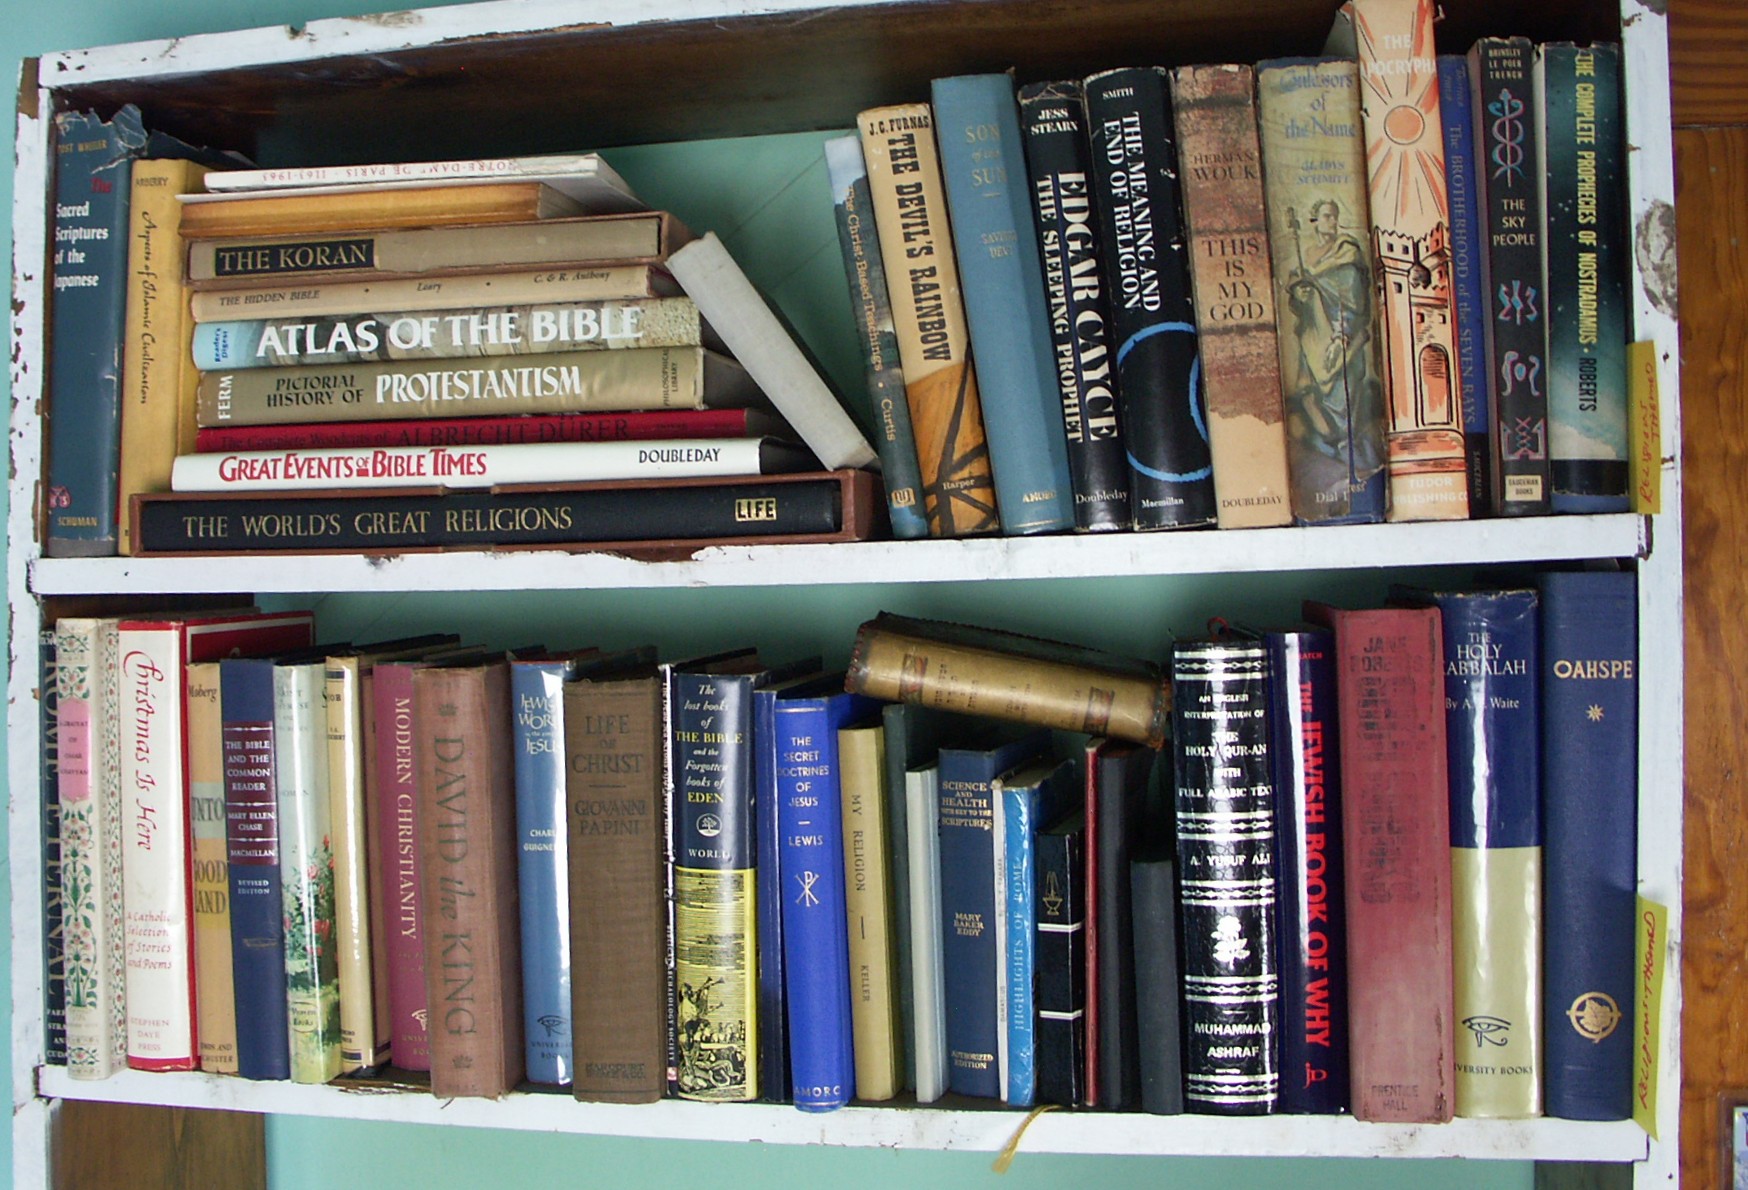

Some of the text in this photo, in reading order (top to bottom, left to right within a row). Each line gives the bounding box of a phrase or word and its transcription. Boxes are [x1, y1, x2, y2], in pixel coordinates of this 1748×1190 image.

[1384, 34, 1411, 49] THE
[1102, 87, 1134, 100] SMITH
[1038, 107, 1069, 120] JESS
[889, 115, 931, 132] FURNAS
[1031, 120, 1079, 136] STEARN
[965, 124, 1000, 144] SON
[1193, 151, 1254, 164] HERMAN
[971, 168, 1008, 188] SUN
[1194, 165, 1258, 181] WOUK
[57, 202, 90, 218] Sacred
[1123, 111, 1161, 312] THE MEANING AND
[1502, 199, 1526, 211] THE
[1104, 119, 1141, 310] END OF RELIGION
[1502, 216, 1526, 229] SKY
[55, 225, 109, 242] Scriptures
[1493, 234, 1536, 246] PEOPLE
[1575, 54, 1599, 412] THE COMPLETE PROPHECIES OF NOSTRADAMUS ROBERTS
[888, 133, 952, 361] THE DEVIL'S RAINBOW
[1202, 237, 1260, 257] THIS
[55, 248, 86, 265] of the
[219, 243, 369, 272] THE KORAN
[1226, 260, 1245, 277] IS
[1448, 123, 1475, 424] The BROTHERHOOD of the SEVEN RAYS
[54, 272, 99, 291] Japanese
[1219, 281, 1254, 299] MY
[219, 290, 321, 307] THE HIDDEN BIBLE
[138, 211, 157, 405] Aspects of Islamic Civilization
[1037, 174, 1084, 444] THE SLEEPING PROPHET
[1057, 172, 1118, 442] EDGAR CAYCE
[1210, 302, 1264, 322] GOD
[255, 306, 644, 357] ATLAS OF THE BIBLE
[275, 375, 357, 391] PICTORIAL
[376, 365, 582, 402] PROTESTANTISM
[218, 375, 233, 420] FERM
[267, 388, 364, 408] HISTORY OF
[881, 398, 896, 441] Curtis
[399, 416, 629, 446] ALBRECHT DÜRER
[638, 448, 721, 464] DOUBLEDAY
[219, 447, 487, 482] GREAT EVENTS OF BIBLE TIMES
[943, 478, 975, 490] Harper
[1076, 489, 1129, 504] Doubleday
[1141, 496, 1184, 509] Macmillan
[1222, 496, 1283, 508] DOUBLEDAY
[1315, 491, 1339, 504] Dial
[183, 499, 776, 538] THE WORLD'S GREAT RELIGIONS LIFE
[1468, 632, 1491, 644] THE
[1457, 644, 1503, 660] HOLY
[1553, 660, 1633, 679] OAHSPE
[699, 684, 717, 696] The
[1299, 681, 1312, 713] THE
[1445, 698, 1520, 711] By Waite
[1254, 709, 1265, 718] OF
[585, 715, 631, 735] LIFE
[701, 716, 712, 729] of
[225, 740, 271, 750] THE BIBLE
[675, 731, 743, 744] THE BIBLE
[791, 736, 812, 746] THE
[123, 650, 164, 851] Christmas Is Here
[693, 748, 719, 756] and the
[784, 751, 819, 762] SECRET
[1185, 745, 1215, 757] HOLY
[228, 754, 270, 764] AND THE
[572, 754, 644, 774] CHRIST
[685, 759, 728, 773] Forgotten
[227, 768, 271, 777] COMMON
[777, 766, 830, 777] DOCTRINES
[1300, 721, 1325, 823] JEWISH
[232, 782, 267, 792] READER
[686, 776, 726, 791] books of
[795, 782, 812, 792] OF
[942, 781, 988, 792] SCIENCE
[688, 792, 725, 804] EDEN
[1178, 787, 1204, 798] FULL
[574, 799, 646, 817] GIOVANNI
[788, 796, 819, 808] JESUS
[943, 797, 988, 808] HEALTH
[228, 812, 275, 820] MARY ELLEN
[395, 697, 417, 940] MODERN CHRISTIANITY
[238, 823, 264, 831] CHASE
[580, 820, 640, 836] PAPINI
[788, 835, 823, 846] LEWIS
[230, 849, 275, 858] MACMILLAN
[688, 848, 731, 859] WORLD
[1207, 853, 1271, 867] YUSUF ALI
[1305, 834, 1329, 923] BOOK
[237, 887, 271, 895] EDITION
[434, 737, 478, 1037] DAVID the KING
[851, 794, 871, 1003] MY RELIGION KELLER
[955, 912, 982, 921] MARY
[127, 926, 170, 938] Selection
[953, 920, 984, 929] BAKER
[956, 928, 981, 937] EDDY
[135, 942, 172, 954] Stories
[1305, 931, 1329, 971] OF
[143, 959, 172, 970] Poems
[1013, 912, 1025, 1030] HIGHLIGHTS OF
[1305, 980, 1331, 1047] WHY
[1195, 1023, 1271, 1035] MUHAMMAD
[137, 1043, 161, 1051] PRESS
[1207, 1046, 1260, 1058] ASHRAF
[952, 1051, 994, 1061] AUTHORIZED
[954, 1060, 988, 1070] EDITION
[1499, 1065, 1533, 1075] BOOKS
